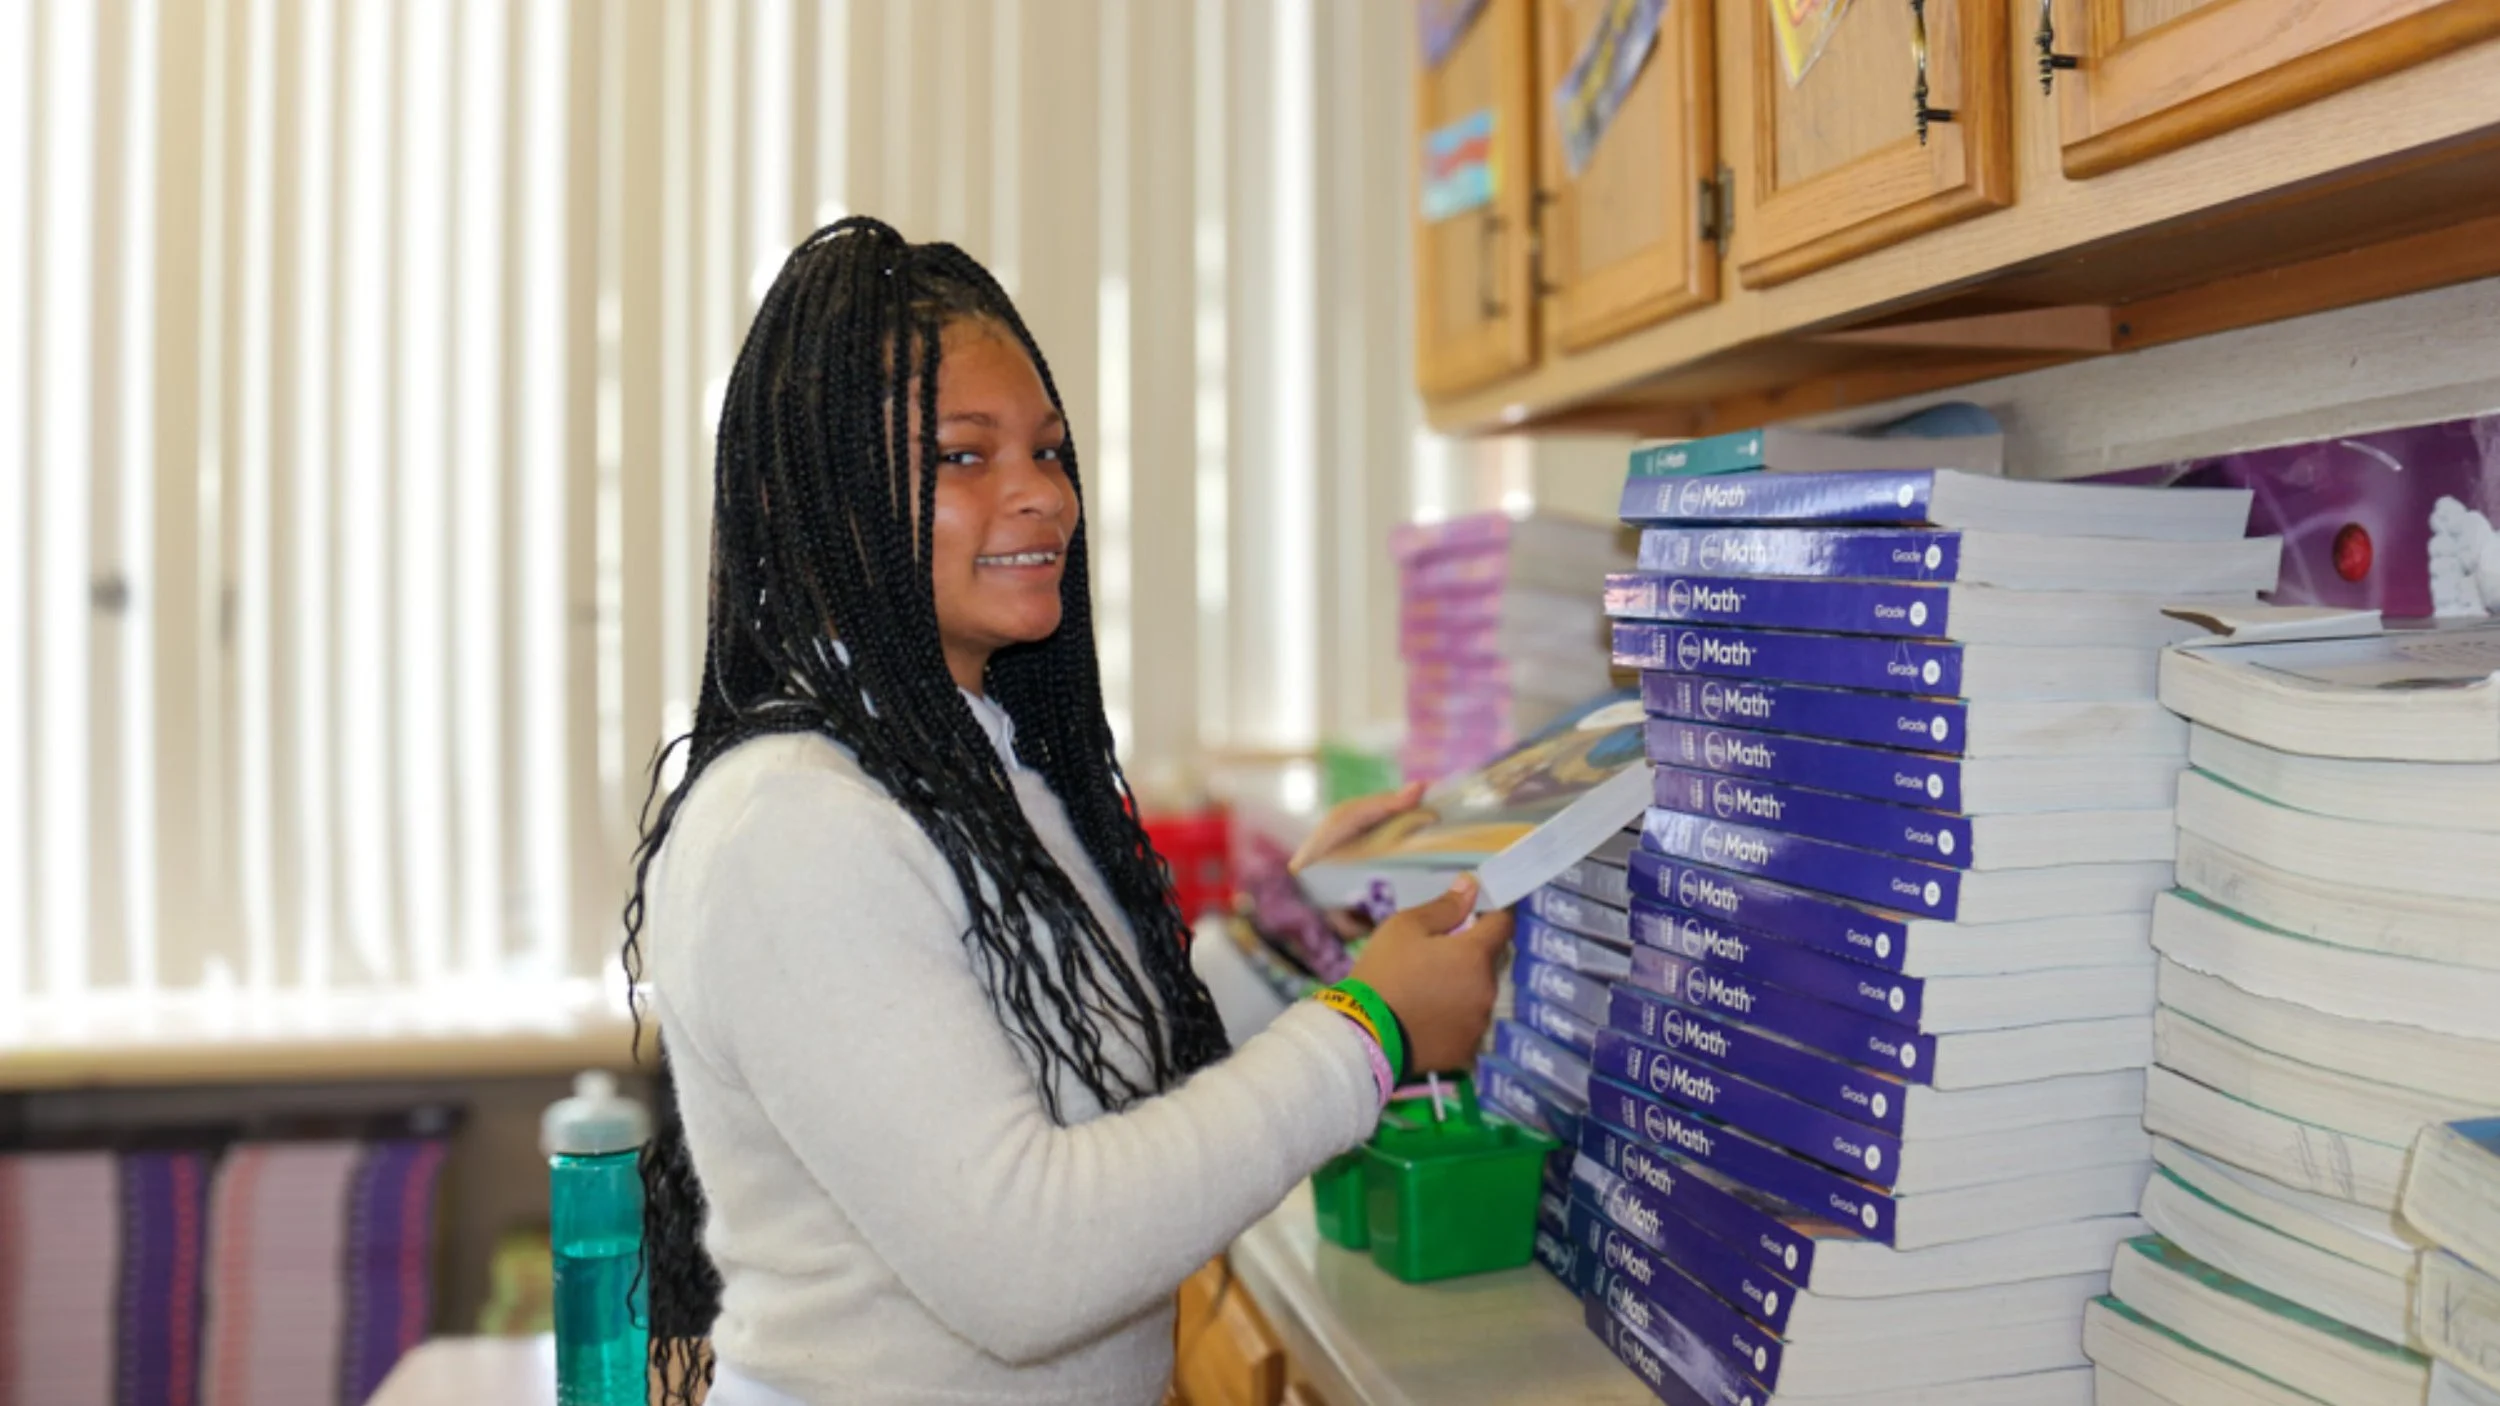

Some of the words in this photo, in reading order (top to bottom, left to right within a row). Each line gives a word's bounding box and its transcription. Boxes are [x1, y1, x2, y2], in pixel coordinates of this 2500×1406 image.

[1702, 483, 1745, 508] Math
[1692, 585, 1740, 612] Math
[1875, 604, 1906, 618] Grade
[1702, 637, 1751, 666] Math
[1887, 662, 1918, 677] Grade
[1725, 689, 1770, 718] Math
[1897, 716, 1927, 732] Grade
[1727, 738, 1771, 768] Math
[1895, 772, 1923, 790] Grade
[1736, 787, 1781, 820] Math
[1905, 827, 1934, 845] Grade
[1724, 832, 1768, 865] Math
[1891, 878, 1921, 896] Grade
[1700, 878, 1738, 912] Math
[1846, 929, 1873, 948] Grade
[1703, 927, 1744, 962] Math
[1858, 981, 1886, 1001] Grade
[1708, 976, 1750, 1013] Math
[1869, 1036, 1897, 1057] Grade
[1685, 1020, 1726, 1058] Math
[1840, 1085, 1869, 1106] Grade
[1672, 1064, 1714, 1104] Math
[1833, 1136, 1861, 1159] Grade
[1637, 1154, 1671, 1196] Math
[1667, 1116, 1710, 1156] Math
[1830, 1194, 1858, 1216] Grade
[1628, 1196, 1660, 1235] Math
[1620, 1243, 1650, 1286] Math
[1620, 1287, 1649, 1329] Math
[1633, 1342, 1661, 1386] Math
